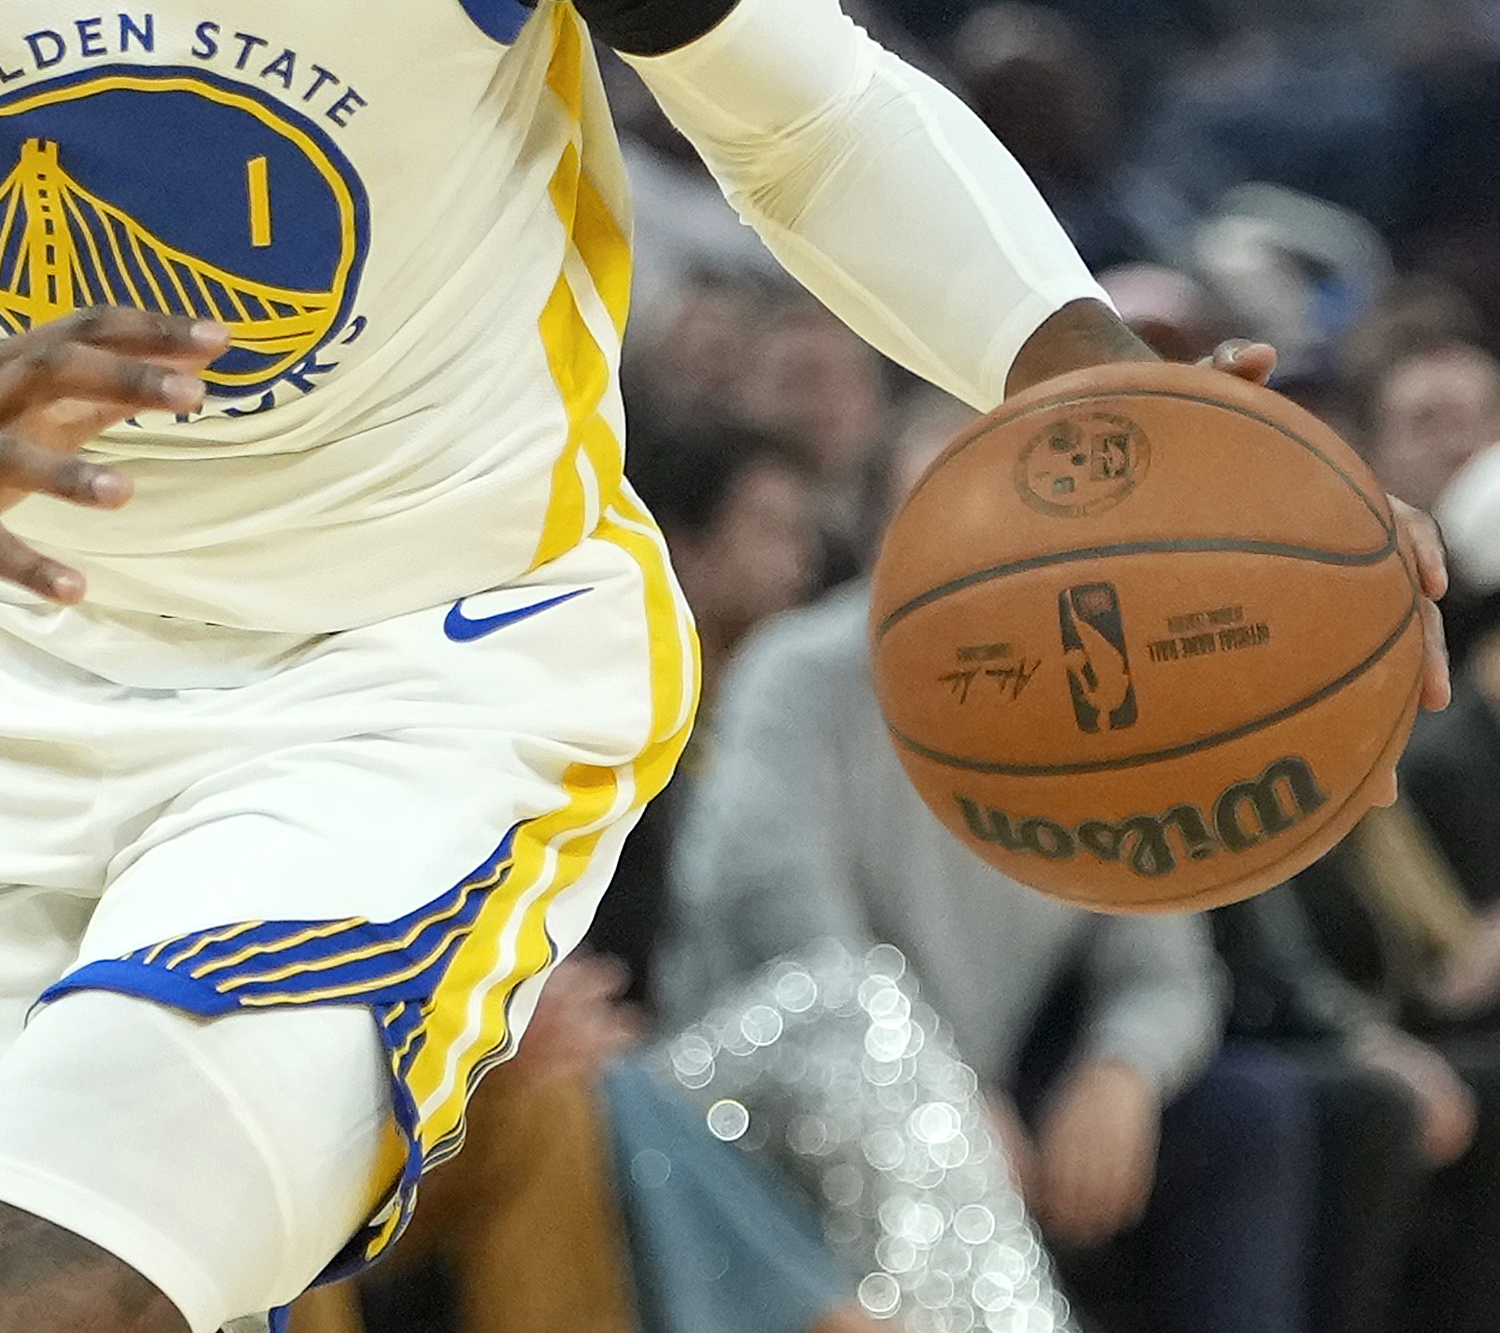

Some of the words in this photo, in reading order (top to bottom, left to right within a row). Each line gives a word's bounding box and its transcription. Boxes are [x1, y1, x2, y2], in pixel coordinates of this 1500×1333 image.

[191, 20, 369, 129] STATE
[246, 155, 272, 248] 1
[953, 756, 1330, 877] Wilson
